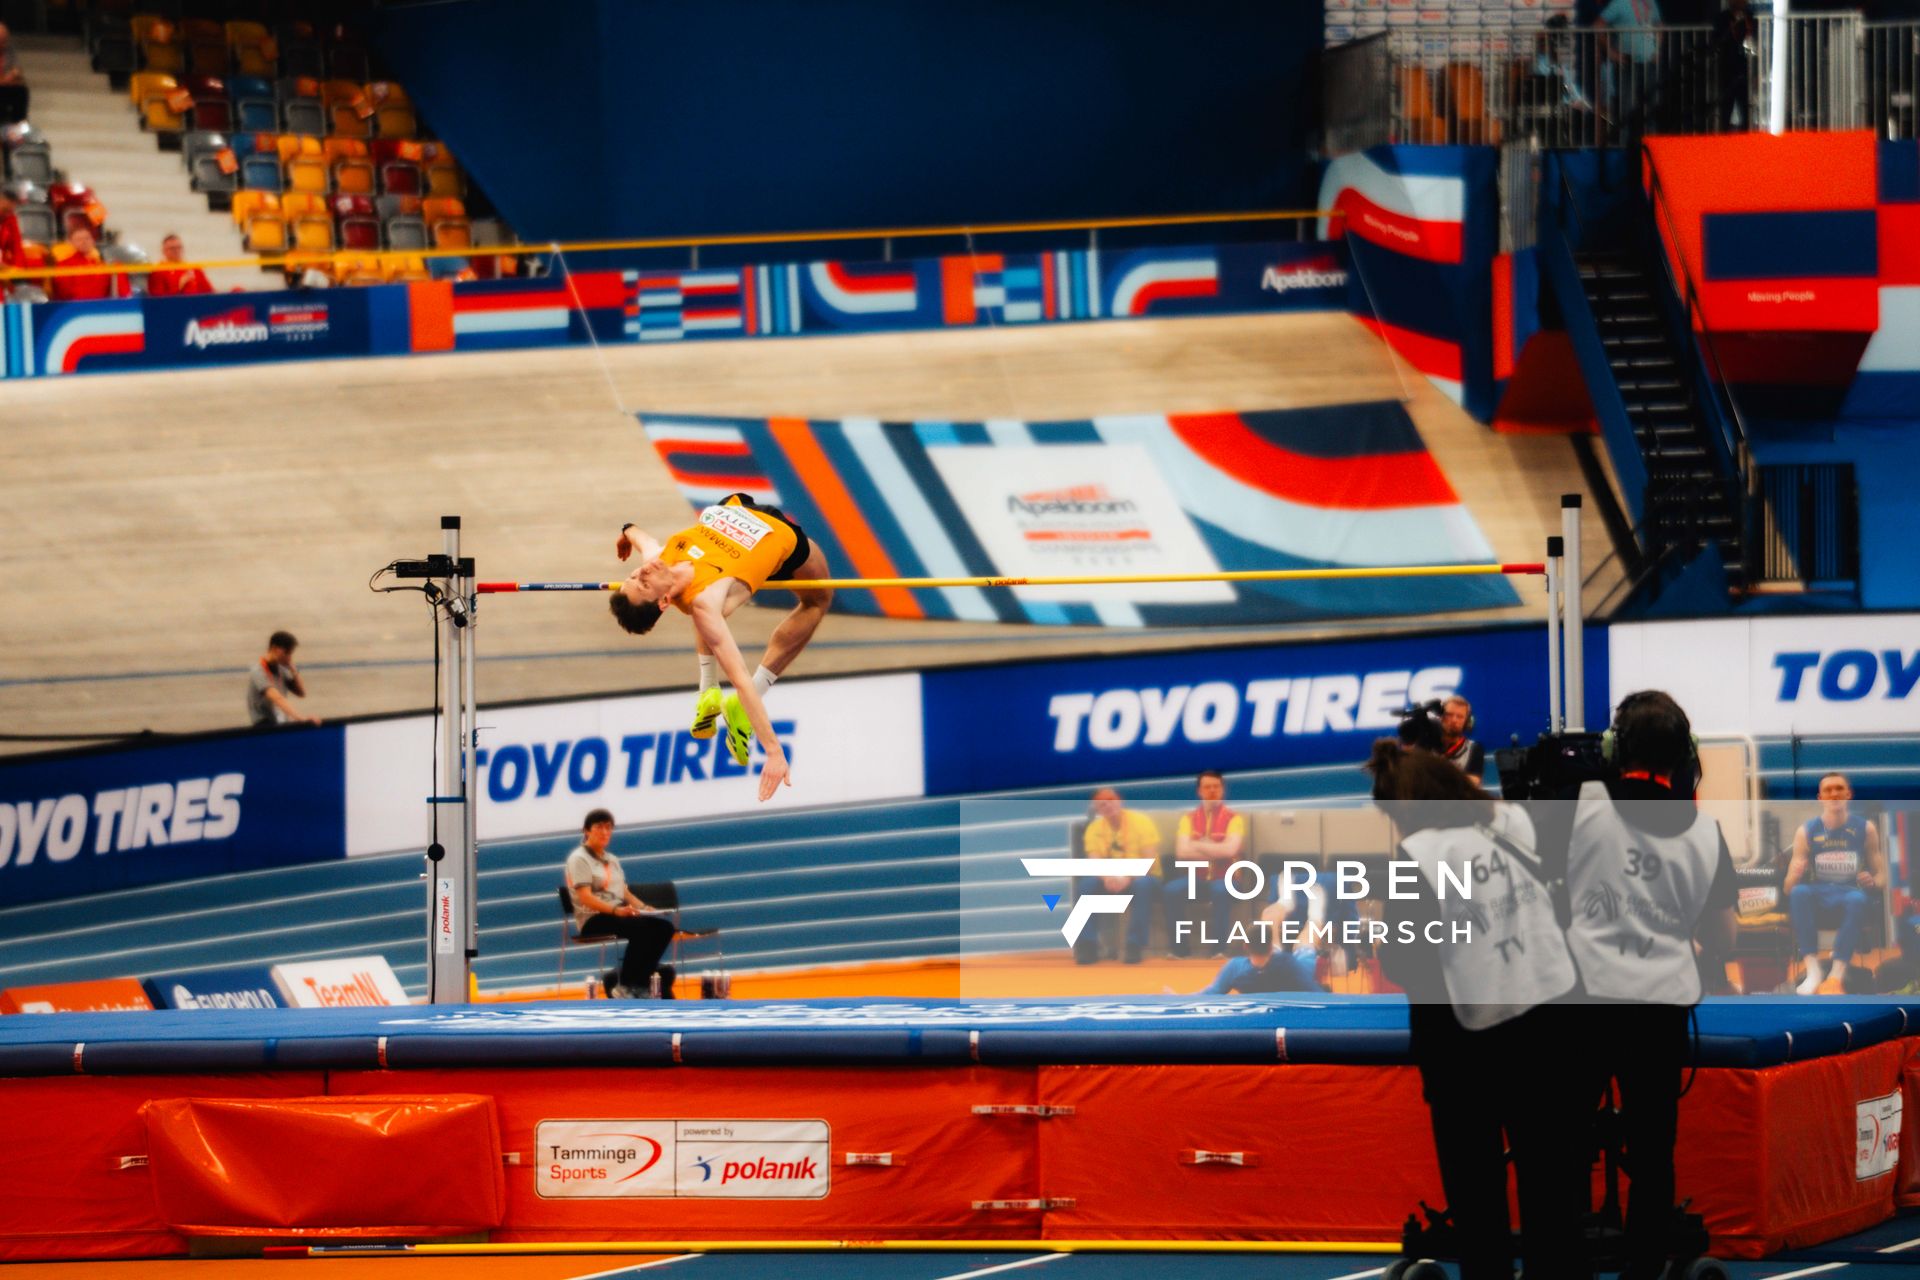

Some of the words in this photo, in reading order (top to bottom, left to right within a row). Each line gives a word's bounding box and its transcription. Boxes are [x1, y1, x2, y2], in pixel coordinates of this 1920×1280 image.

[713, 519, 758, 549] SPAR
[1048, 681, 1239, 752] TOYO
[1245, 665, 1462, 737] TIRES
[94, 772, 245, 855] TIRES
[1471, 849, 1507, 884] 64
[1624, 847, 1662, 882] 39
[441, 895, 452, 934] polanik
[303, 970, 389, 1008] TeamNL
[683, 1127, 721, 1137] powered
[724, 1127, 734, 1137] by
[550, 1145, 637, 1163] Tamminga
[722, 1156, 818, 1185] polanik
[550, 1165, 607, 1183] Sports
